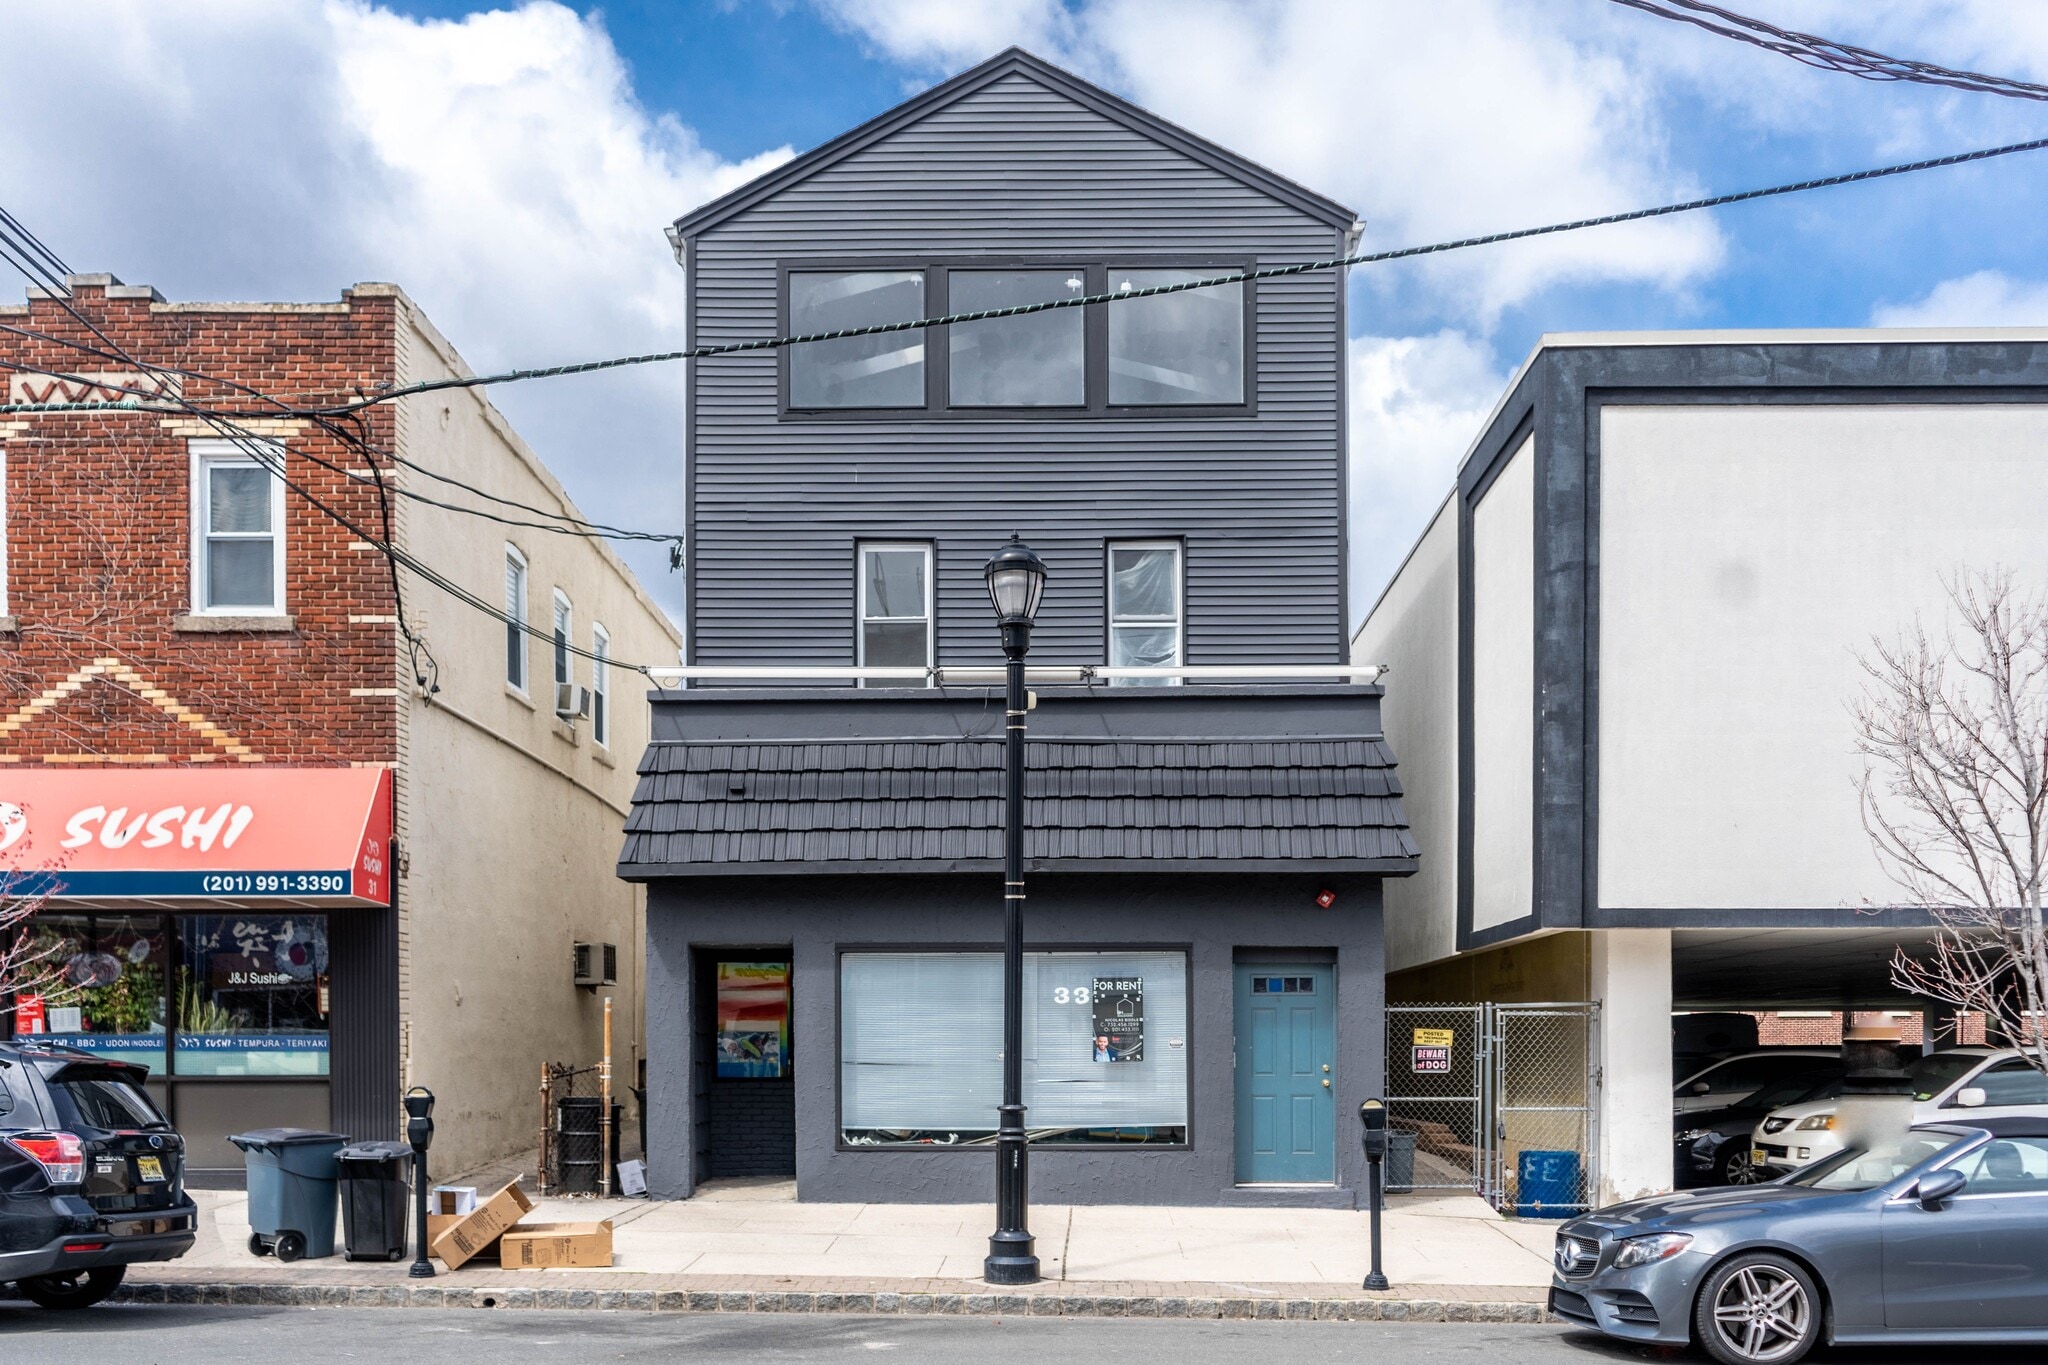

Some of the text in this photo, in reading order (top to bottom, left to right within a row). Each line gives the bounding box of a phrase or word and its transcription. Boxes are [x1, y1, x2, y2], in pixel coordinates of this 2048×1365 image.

[60, 803, 254, 853] SUSHI
[363, 855, 382, 877] SUSHI
[203, 875, 344, 892] (201) 991-3390
[368, 878, 377, 896] 31
[228, 971, 278, 985] J&J Sushi
[1093, 981, 1142, 991] FOR RENT
[1054, 986, 1090, 1005] 33
[77, 1039, 96, 1048] BBQ
[105, 1039, 130, 1048] UDON
[205, 1038, 232, 1048] SUSHI
[238, 1039, 280, 1048] TEMPURA
[286, 1039, 328, 1048] TERIYAKI
[1417, 1049, 1447, 1058] BEWARE
[1417, 1061, 1447, 1069] of DOG
